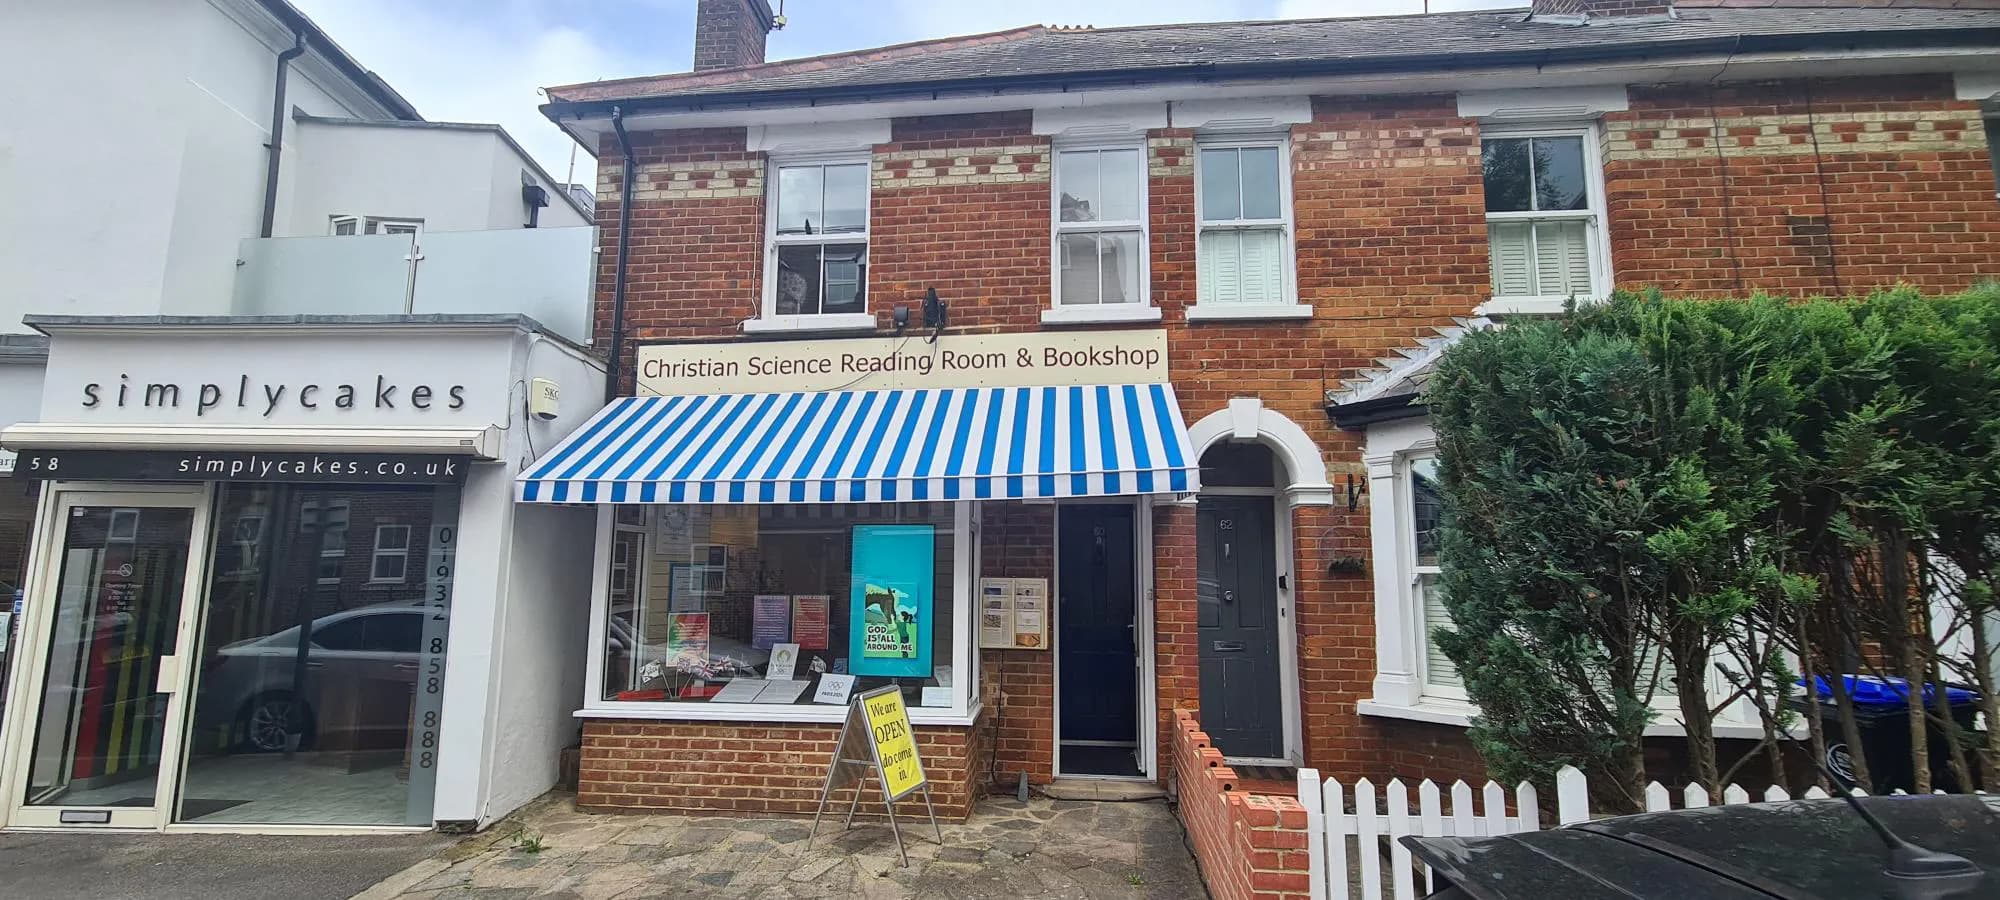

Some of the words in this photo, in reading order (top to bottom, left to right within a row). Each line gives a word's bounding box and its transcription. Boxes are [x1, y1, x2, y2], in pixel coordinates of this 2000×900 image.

[643, 358, 739, 378] Christian
[747, 356, 832, 376] Science
[841, 351, 931, 376] Reading
[941, 350, 1006, 370] Room
[1016, 347, 1034, 367] &
[1044, 345, 1160, 370] Bookshop
[82, 373, 465, 417] simplycakes
[178, 455, 456, 477] simplycakes.co.uk
[1220, 519, 1233, 530] 62
[867, 625, 887, 634] GOD
[867, 634, 877, 642] IS
[880, 634, 895, 642] ALL
[866, 643, 898, 651] AROUND
[901, 643, 913, 651] ME
[426, 637, 443, 694] 858
[870, 702, 884, 717] We
[884, 702, 897, 714] are
[420, 710, 436, 769] 888
[874, 718, 906, 744] OPEN
[882, 752, 894, 769] do
[893, 747, 913, 764] come
[898, 766, 908, 781] in
